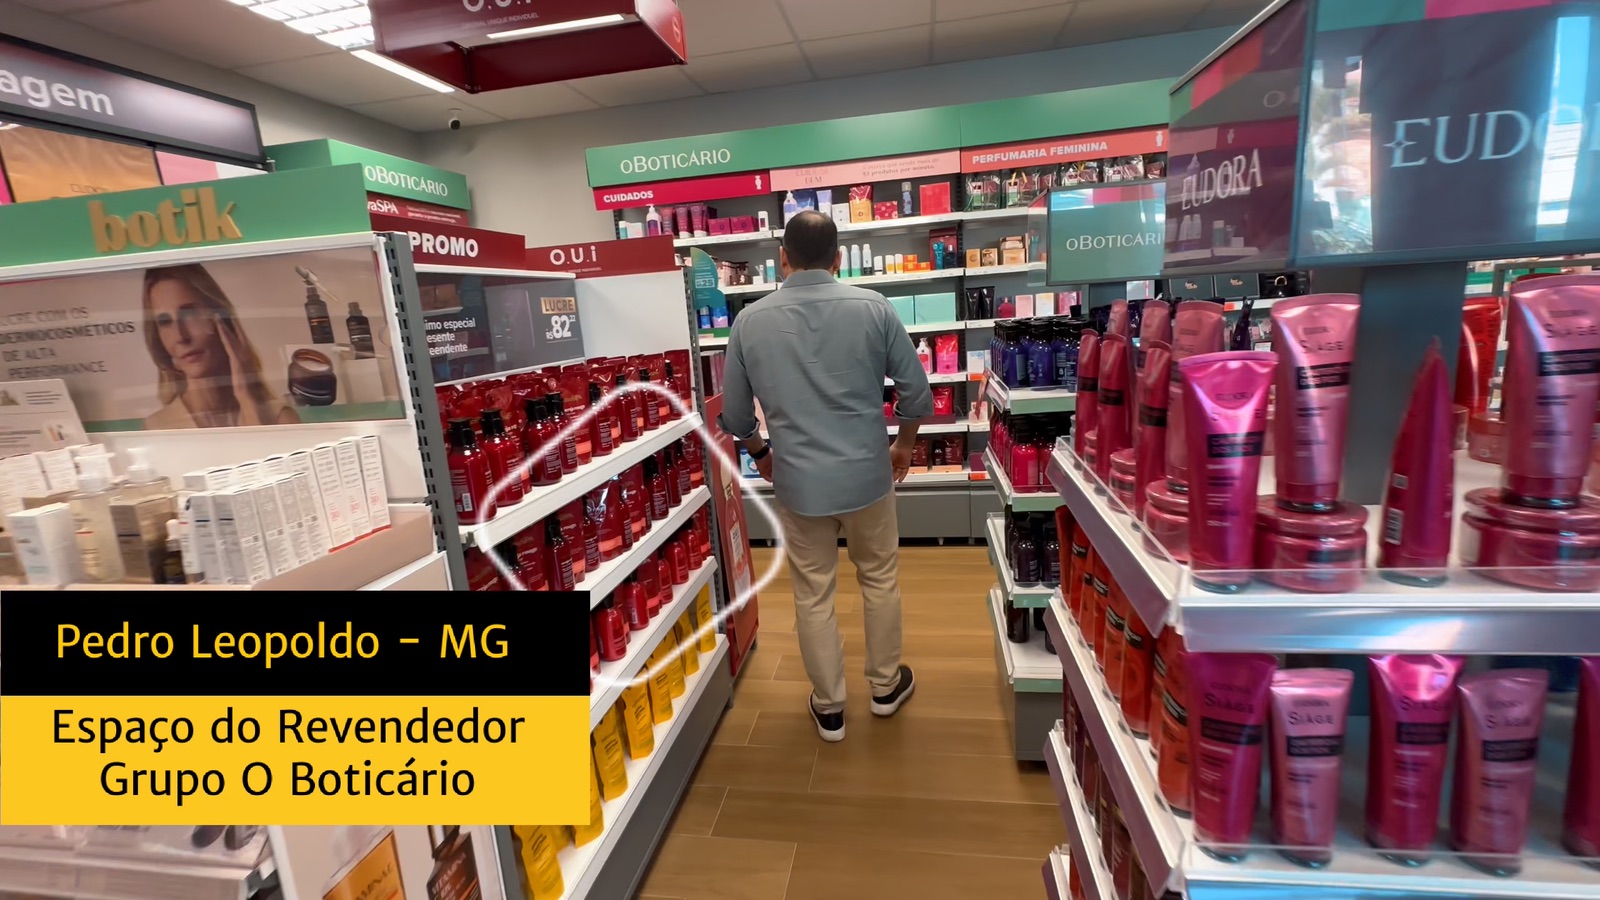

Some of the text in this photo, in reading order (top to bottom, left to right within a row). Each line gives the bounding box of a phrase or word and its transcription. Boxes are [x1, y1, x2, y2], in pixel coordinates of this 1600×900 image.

[972, 141, 1108, 164] PERFUMARIA FEMININA
[1181, 148, 1263, 211] EUDORA
[603, 190, 654, 203] CUIDADOS
[87, 187, 243, 254] botik
[408, 231, 479, 258] PROMO
[543, 299, 574, 312] LUCRE
[443, 317, 476, 331] especial
